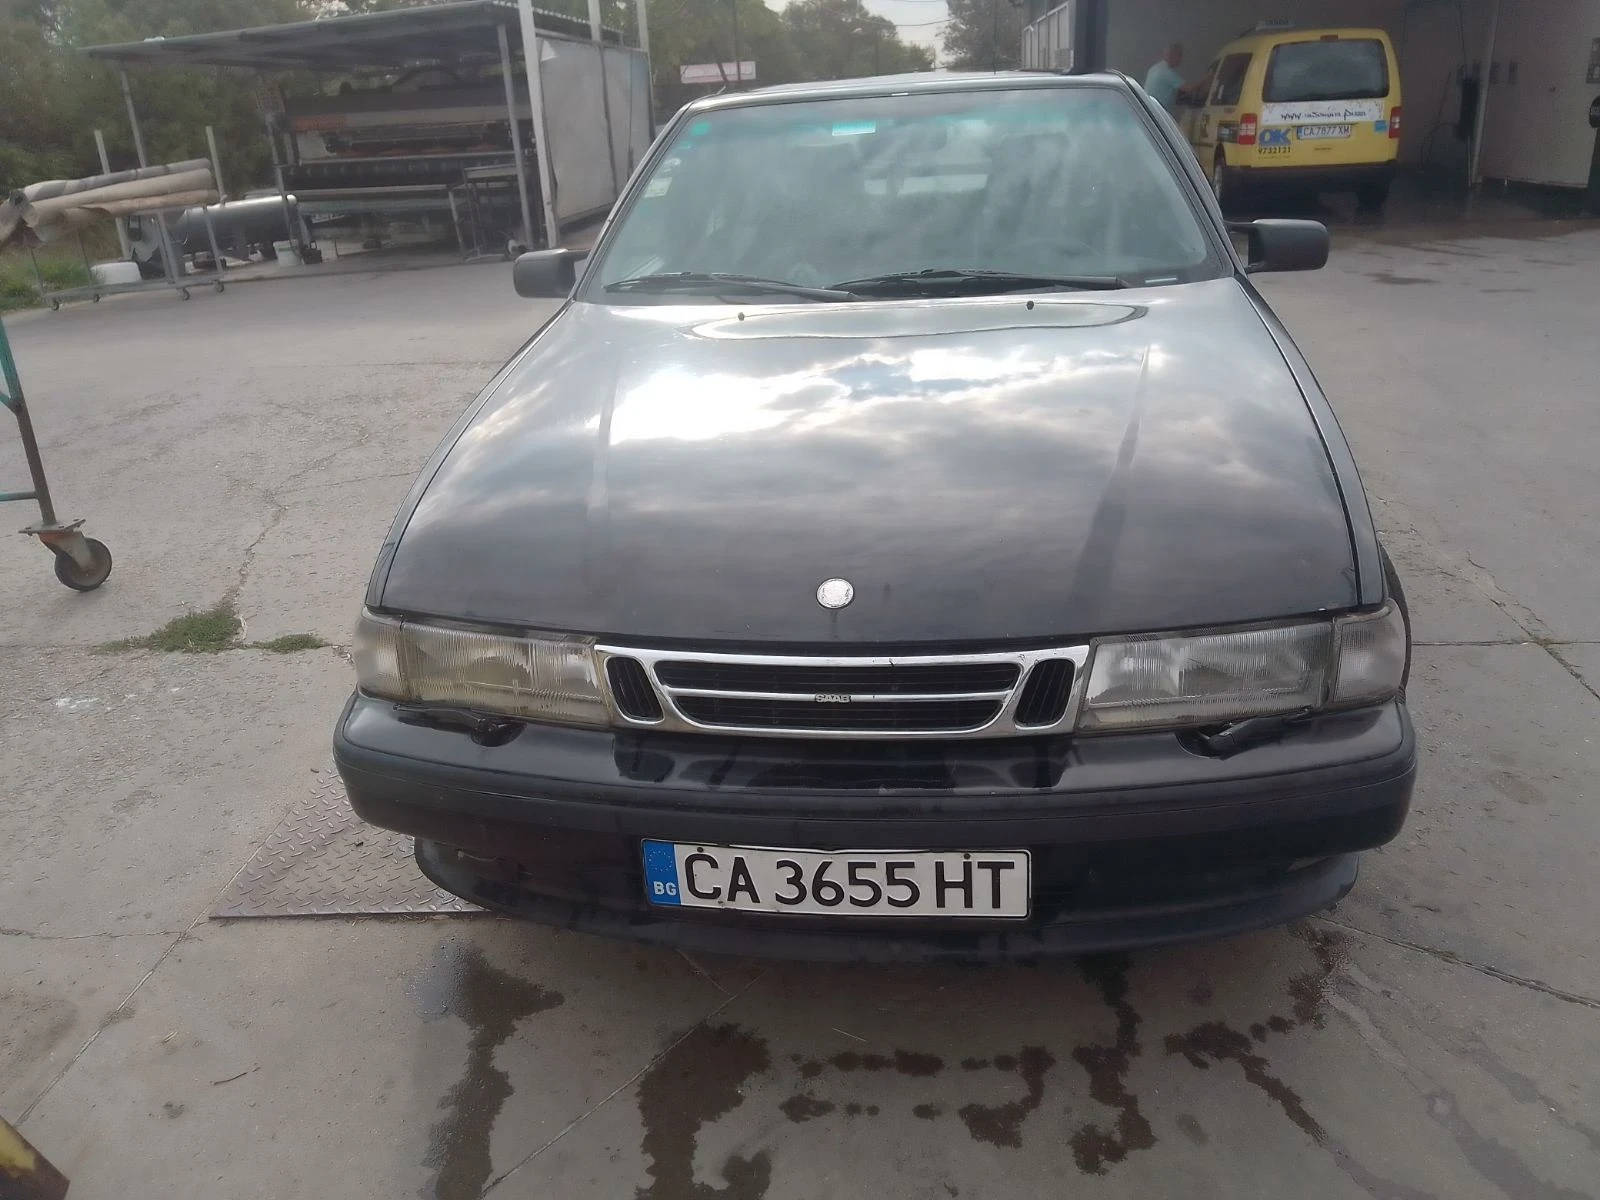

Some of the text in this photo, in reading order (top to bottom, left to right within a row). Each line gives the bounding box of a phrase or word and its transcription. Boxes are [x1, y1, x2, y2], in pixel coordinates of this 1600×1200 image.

[815, 693, 851, 703] SAAB
[654, 880, 677, 897] BG
[684, 853, 1015, 909] CA 3655 HT
